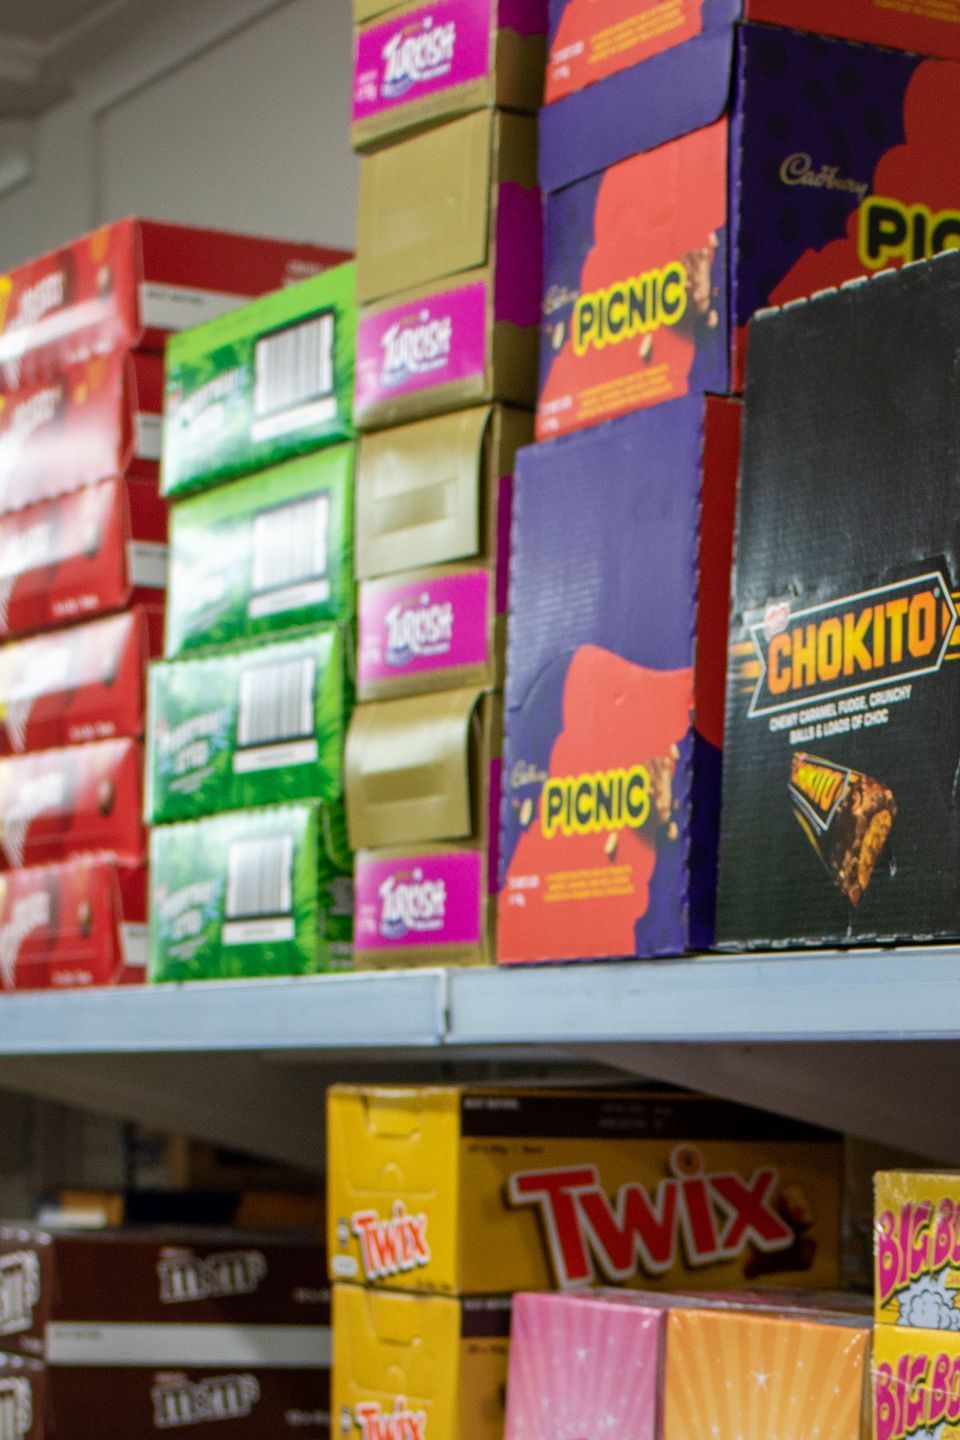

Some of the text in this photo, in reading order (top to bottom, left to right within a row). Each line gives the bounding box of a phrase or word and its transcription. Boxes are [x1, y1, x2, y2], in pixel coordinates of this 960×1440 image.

[572, 263, 688, 357] PICNIC
[767, 590, 937, 696] CHOKITO
[541, 765, 651, 839] PICNIC
[877, 1200, 933, 1300] BIG
